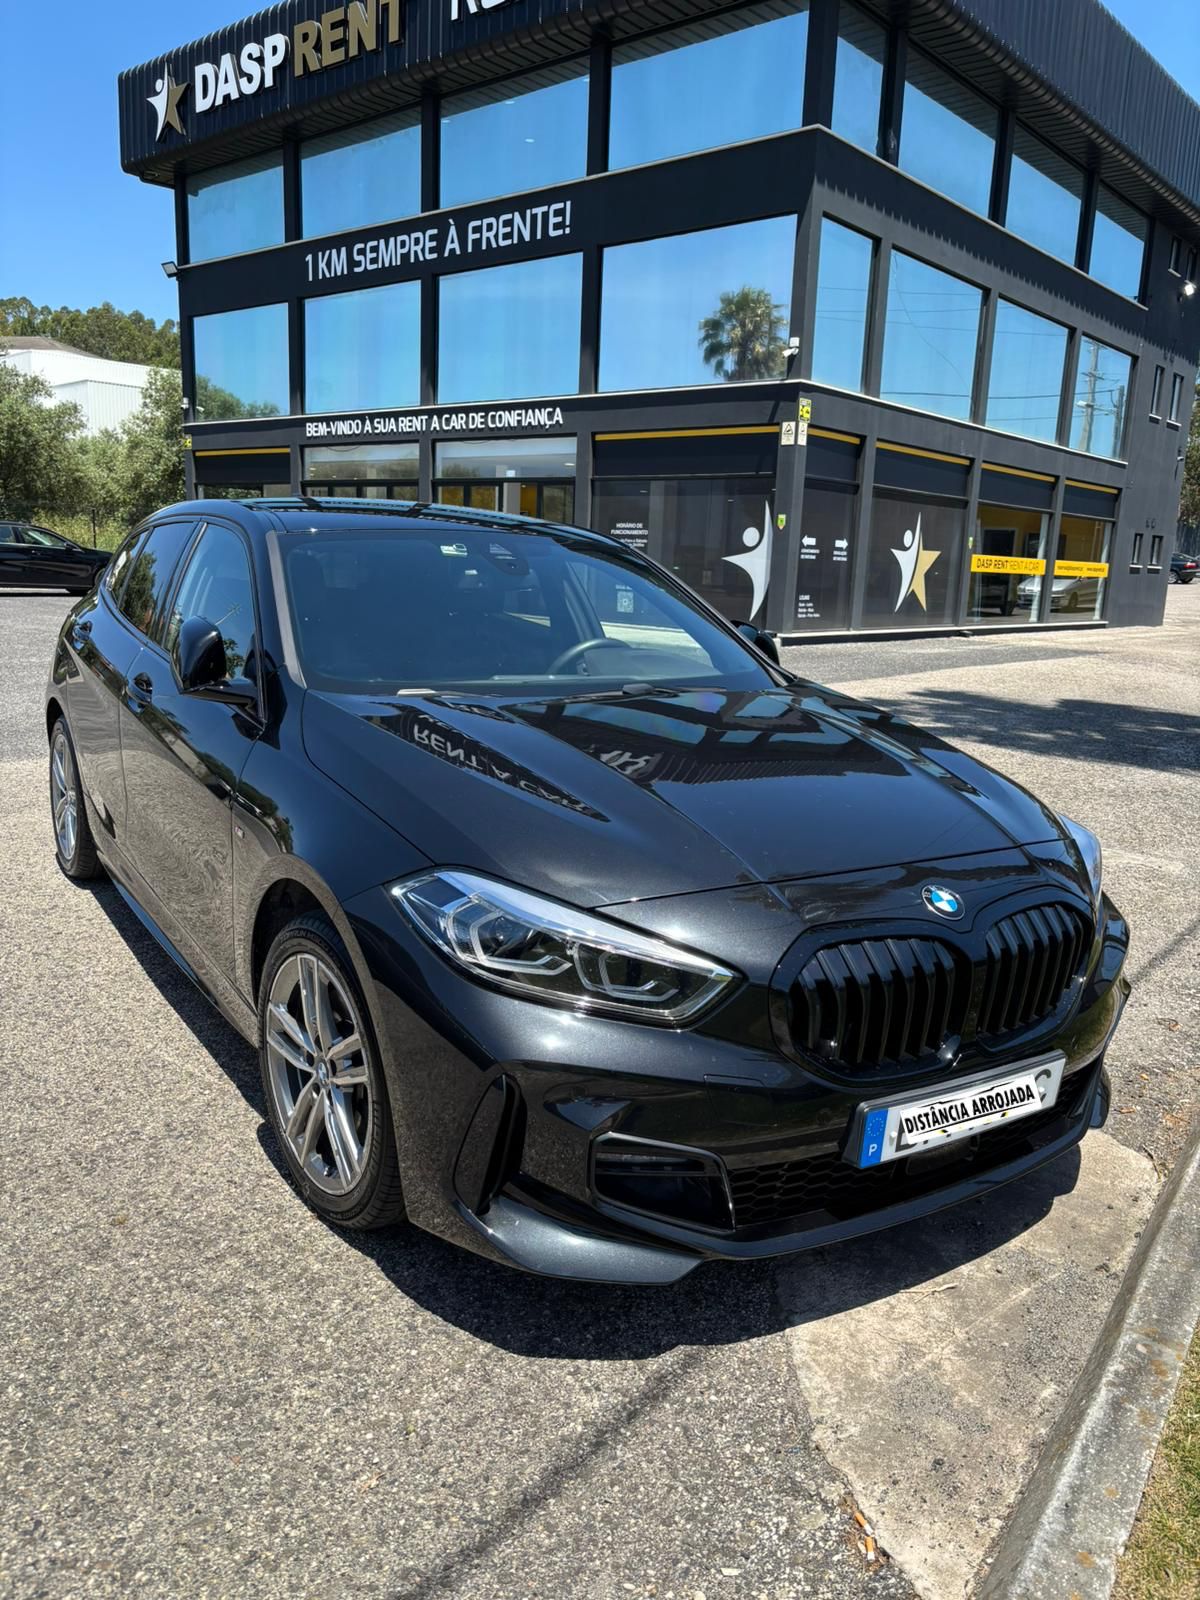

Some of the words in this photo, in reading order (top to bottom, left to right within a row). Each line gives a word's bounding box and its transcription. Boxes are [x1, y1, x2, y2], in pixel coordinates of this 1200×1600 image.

[195, 33, 288, 113] DASP
[294, 0, 401, 77] RENT
[305, 253, 313, 283] 1
[317, 248, 348, 281] KM
[353, 228, 438, 273] SEMPRE
[444, 219, 461, 257] À
[467, 201, 572, 252] FRENTE!
[306, 419, 362, 437] BEM-VINDO
[363, 415, 372, 434] À
[374, 417, 397, 433] SUA
[398, 415, 428, 432] RENT
[430, 414, 440, 431] A
[442, 413, 466, 430] CAR
[468, 412, 485, 429] DE
[487, 407, 563, 429] CONFIANÇA
[976, 558, 993, 569] DASP
[993, 559, 1008, 570] RENT
[868, 1143, 878, 1156] P
